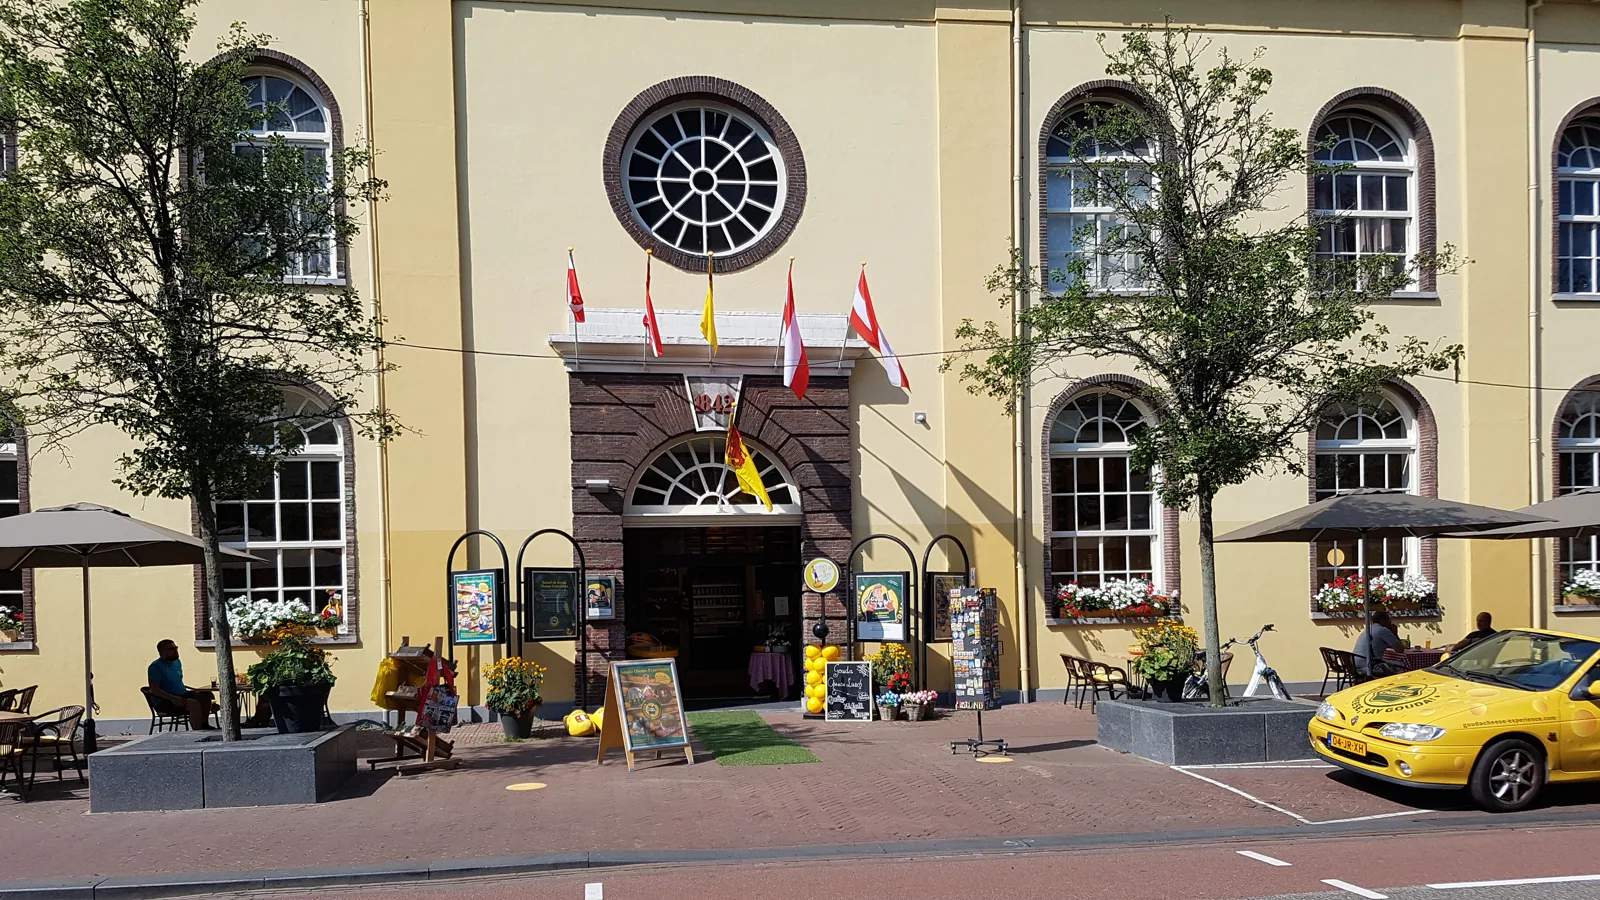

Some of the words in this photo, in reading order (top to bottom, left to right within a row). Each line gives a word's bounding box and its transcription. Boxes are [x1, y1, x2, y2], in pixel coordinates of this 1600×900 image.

[695, 394, 735, 414] 1842
[833, 663, 853, 678] Gouda
[1362, 706, 1383, 715] SAY
[1385, 697, 1437, 713] GOUDA!
[1463, 716, 1557, 729] goudacheese-experience.com
[1332, 735, 1364, 755] 04-JR-XH
